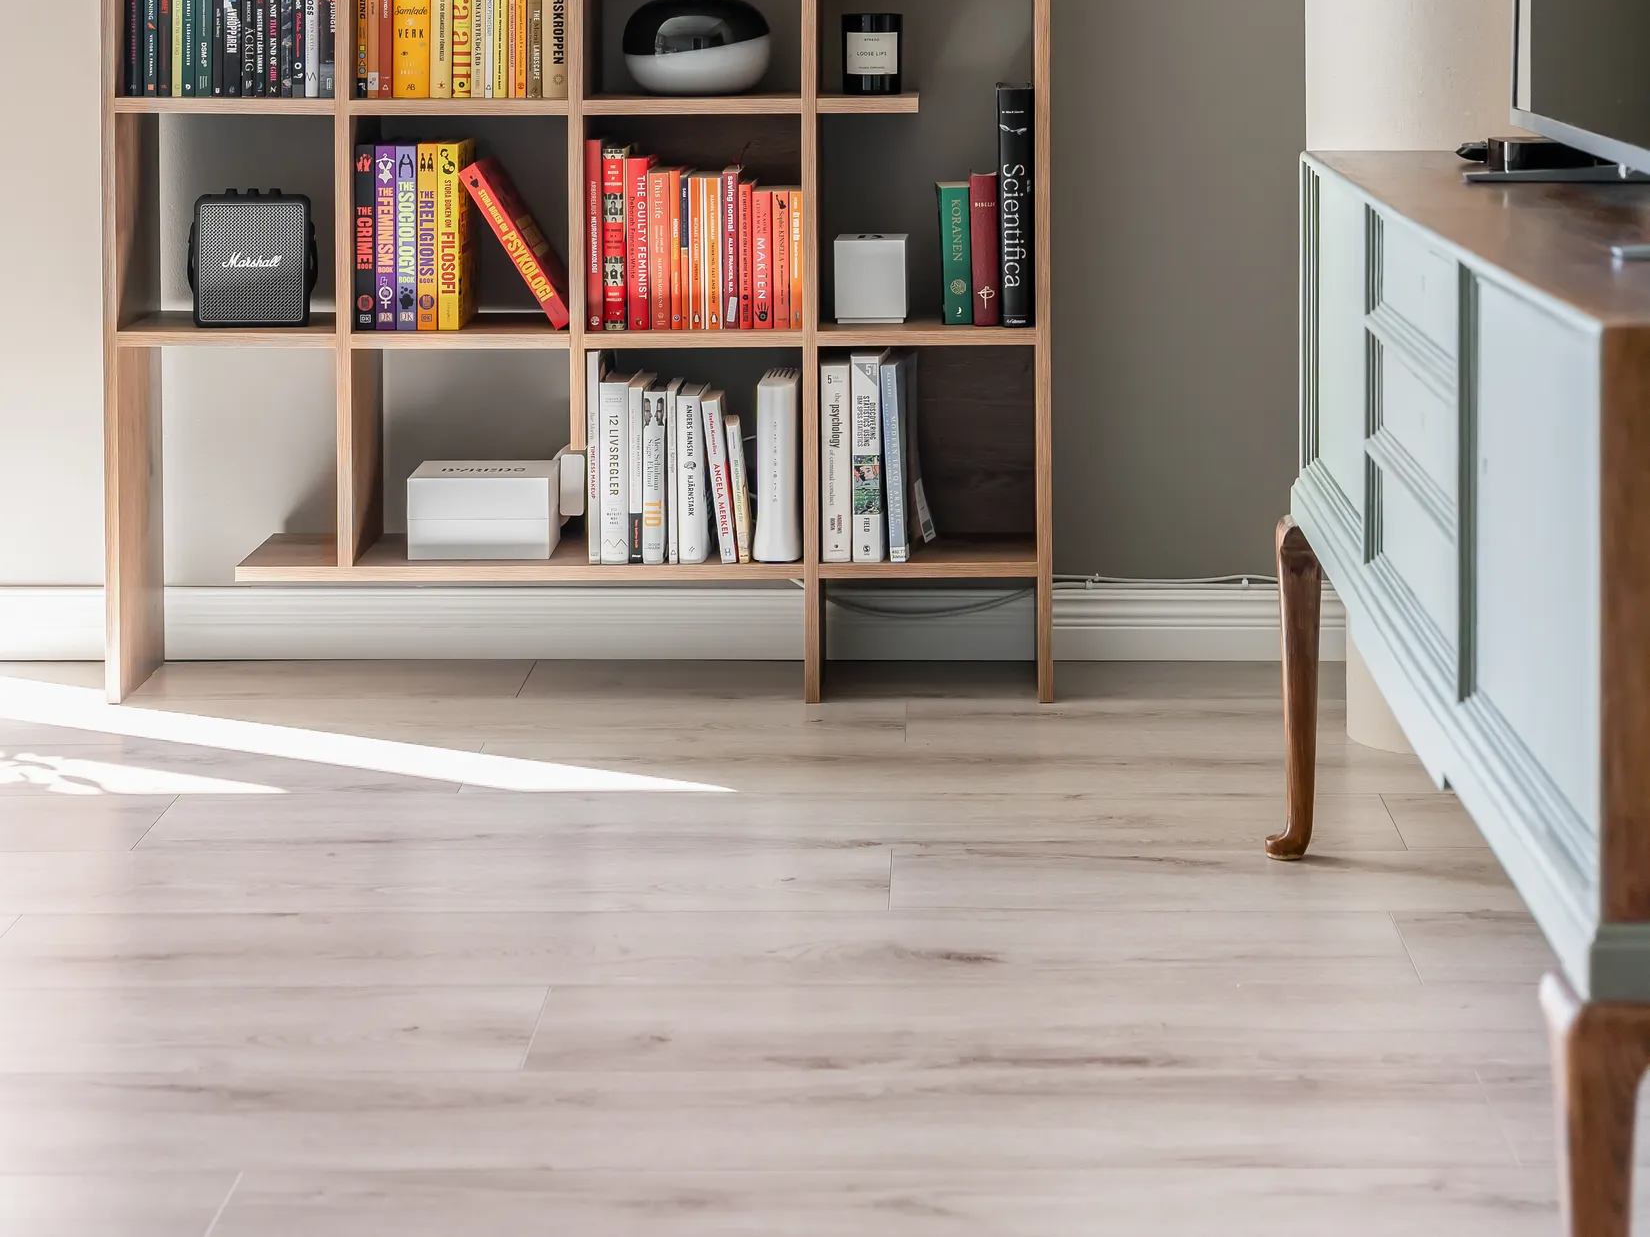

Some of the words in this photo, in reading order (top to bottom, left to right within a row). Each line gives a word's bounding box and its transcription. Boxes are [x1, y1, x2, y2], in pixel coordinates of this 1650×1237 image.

[394, 6, 428, 15] Samlade
[245, 27, 255, 72] ÄCKLIG
[398, 29, 424, 38] VERK
[270, 57, 276, 66] OF
[452, 30, 471, 96] allt!
[378, 188, 394, 196] THE
[399, 182, 414, 191] THE
[420, 191, 434, 199] THE
[444, 180, 452, 198] STORA
[637, 175, 646, 196] THE
[654, 178, 662, 198] This
[357, 207, 372, 215] THE
[444, 200, 452, 218] BOKEN
[444, 219, 452, 228] OM
[478, 189, 493, 209] STORA
[490, 205, 503, 225] BOKEN
[499, 222, 509, 233] OM
[637, 206, 646, 242] GUILTY
[655, 201, 663, 218] Life
[1002, 163, 1026, 289] Scientifica
[357, 217, 372, 264] CRIME
[378, 197, 394, 266] FEMINISM
[399, 191, 414, 276] SOCIOLOGY
[420, 201, 434, 276] RELIGIONS
[951, 199, 962, 262] KORANEN
[222, 252, 282, 268] Marshall
[441, 232, 456, 294] FILOSOFI
[502, 231, 554, 302] PSYKOLOGI
[638, 246, 647, 299] FEMINIST
[756, 238, 767, 299] MAKTEN
[609, 415, 618, 425] 12
[828, 404, 843, 448] psychology
[609, 429, 618, 495] LIVSREGLER
[653, 436, 661, 452] Alex
[653, 454, 661, 490] Schulman
[644, 500, 662, 527] TID
[687, 475, 695, 516] HJÄRNSTARK
[713, 464, 723, 498] ANGELA
[718, 502, 728, 536] MERKEL
[863, 518, 871, 532] FIELD
